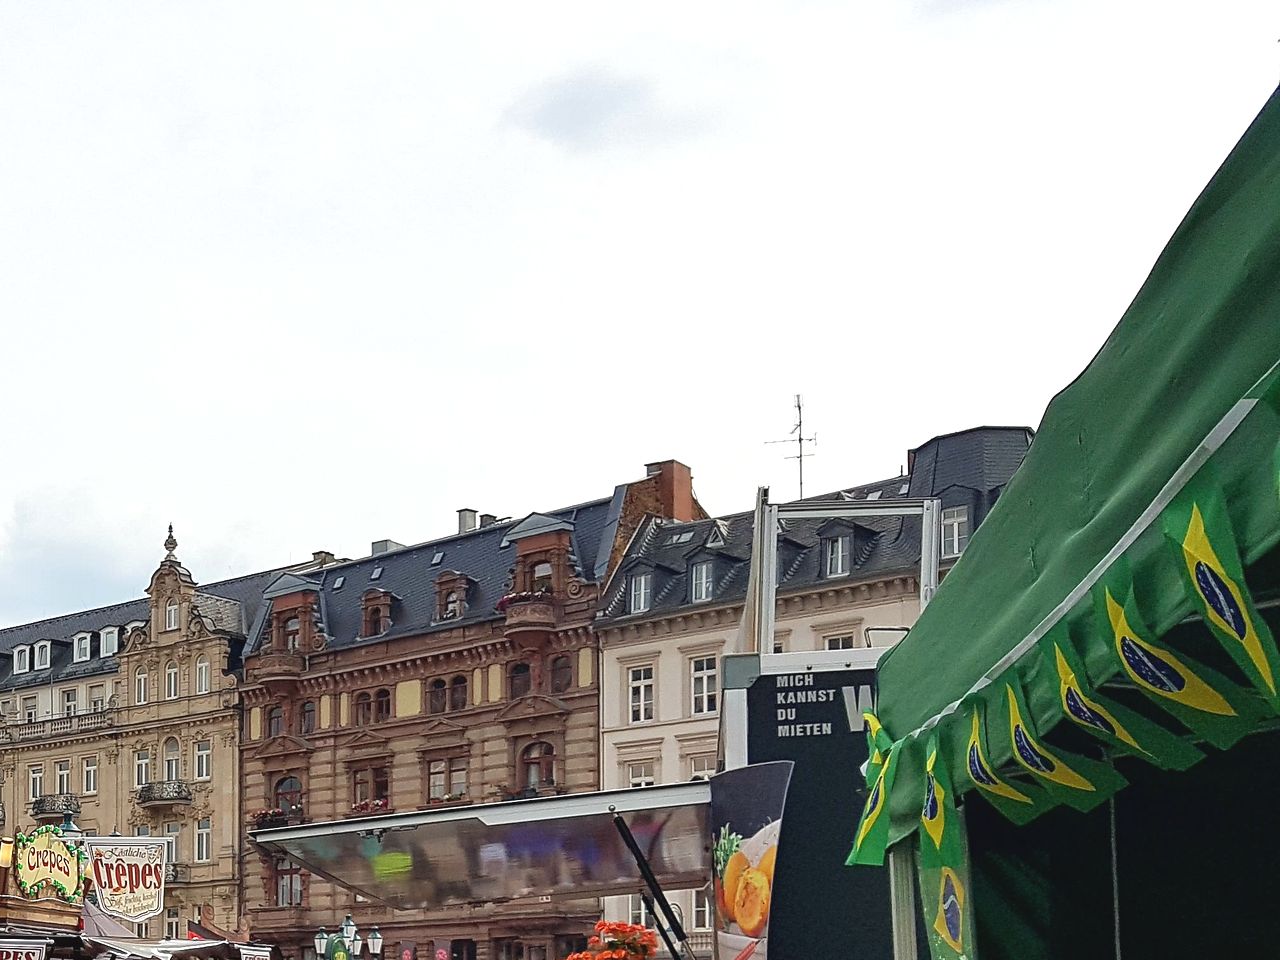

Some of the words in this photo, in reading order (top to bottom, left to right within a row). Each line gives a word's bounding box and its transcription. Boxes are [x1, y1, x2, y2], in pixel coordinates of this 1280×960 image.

[776, 674, 814, 688] MICH
[777, 689, 837, 704] KANNST
[777, 708, 797, 721] DU
[777, 722, 833, 737] MIETEN
[27, 846, 71, 878] Crepes
[93, 857, 162, 894] Crêpes
